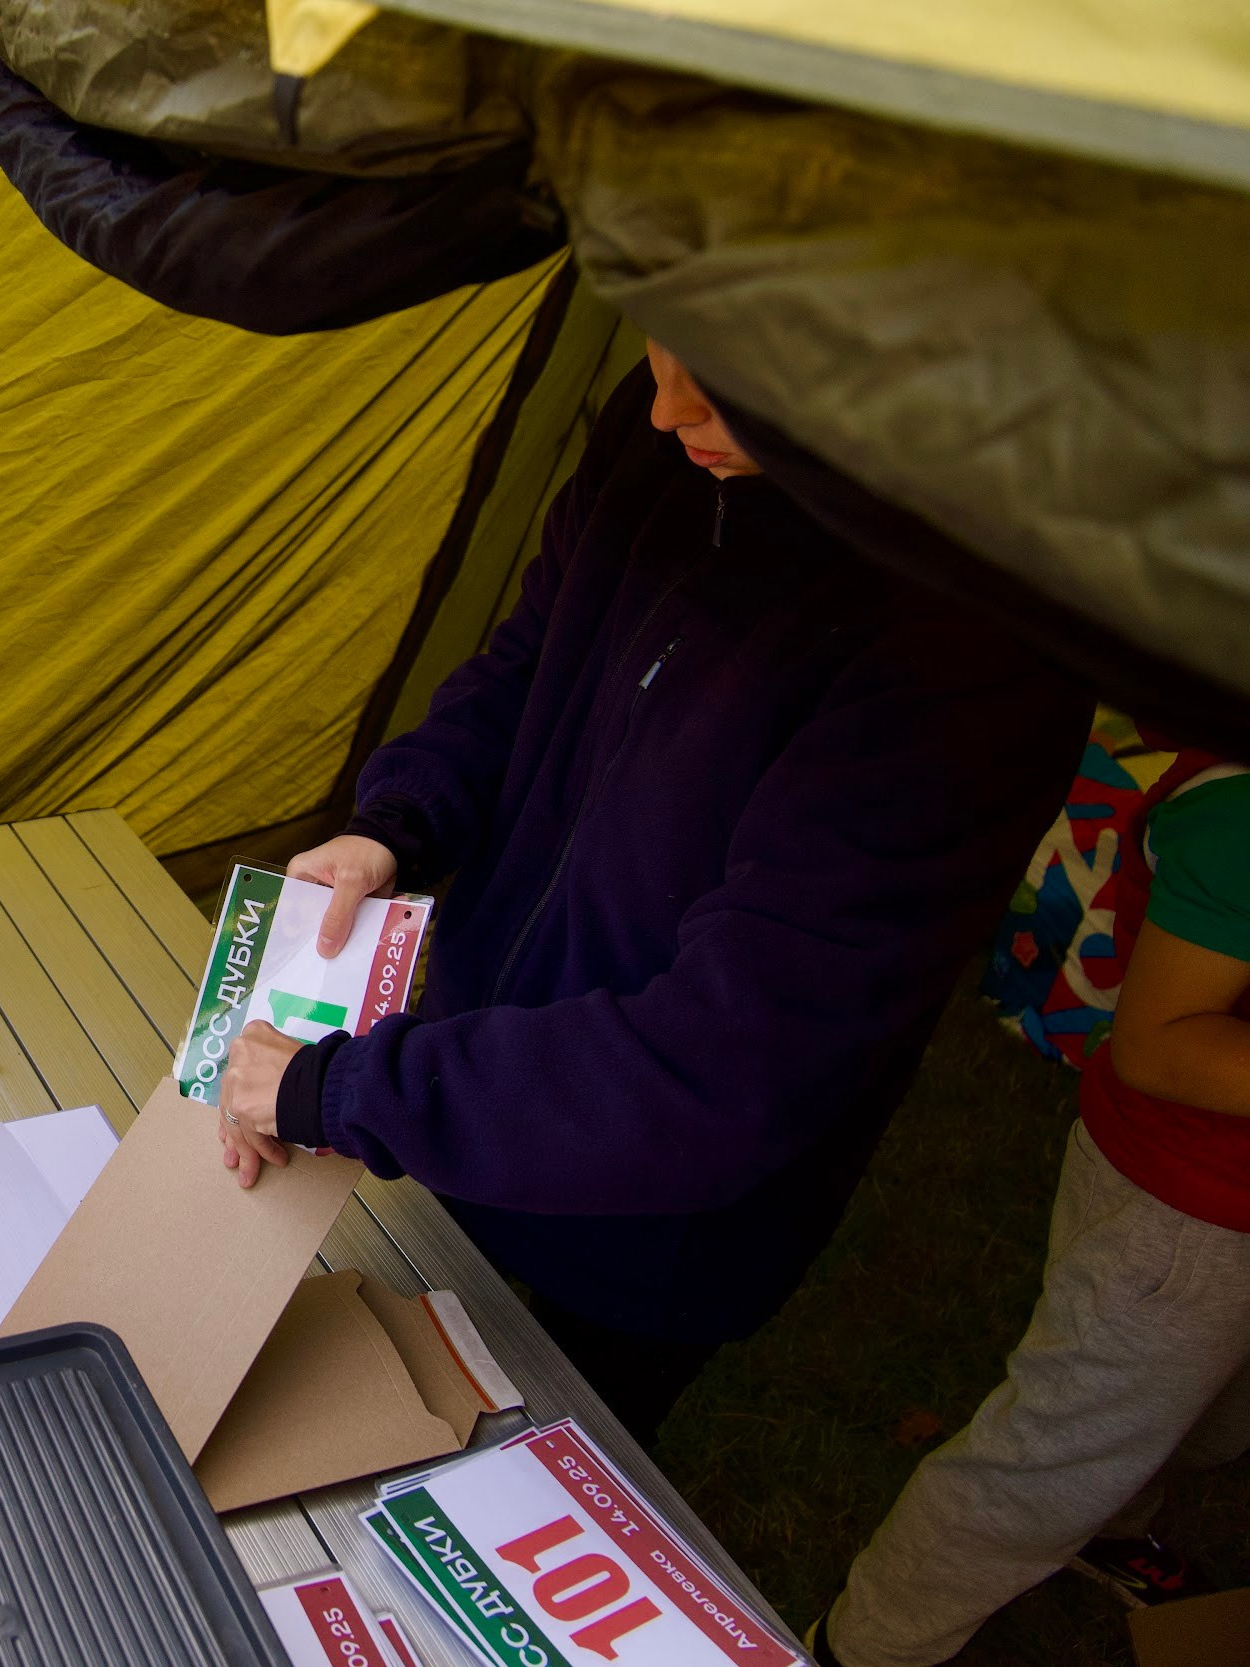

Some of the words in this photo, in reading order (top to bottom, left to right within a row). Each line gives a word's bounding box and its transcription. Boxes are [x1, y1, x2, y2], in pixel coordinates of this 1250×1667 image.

[188, 1012, 232, 1102] РОСС
[216, 898, 266, 1009] ДУБКИ
[268, 989, 348, 1045] 1
[557, 1455, 640, 1537] 14.09.25
[413, 1515, 515, 1619] ДУБКИ
[495, 1514, 663, 1661] 101
[650, 1550, 758, 1649] Апрелевка
[323, 1607, 368, 1667] 09.25
[501, 1622, 549, 1667] СС
